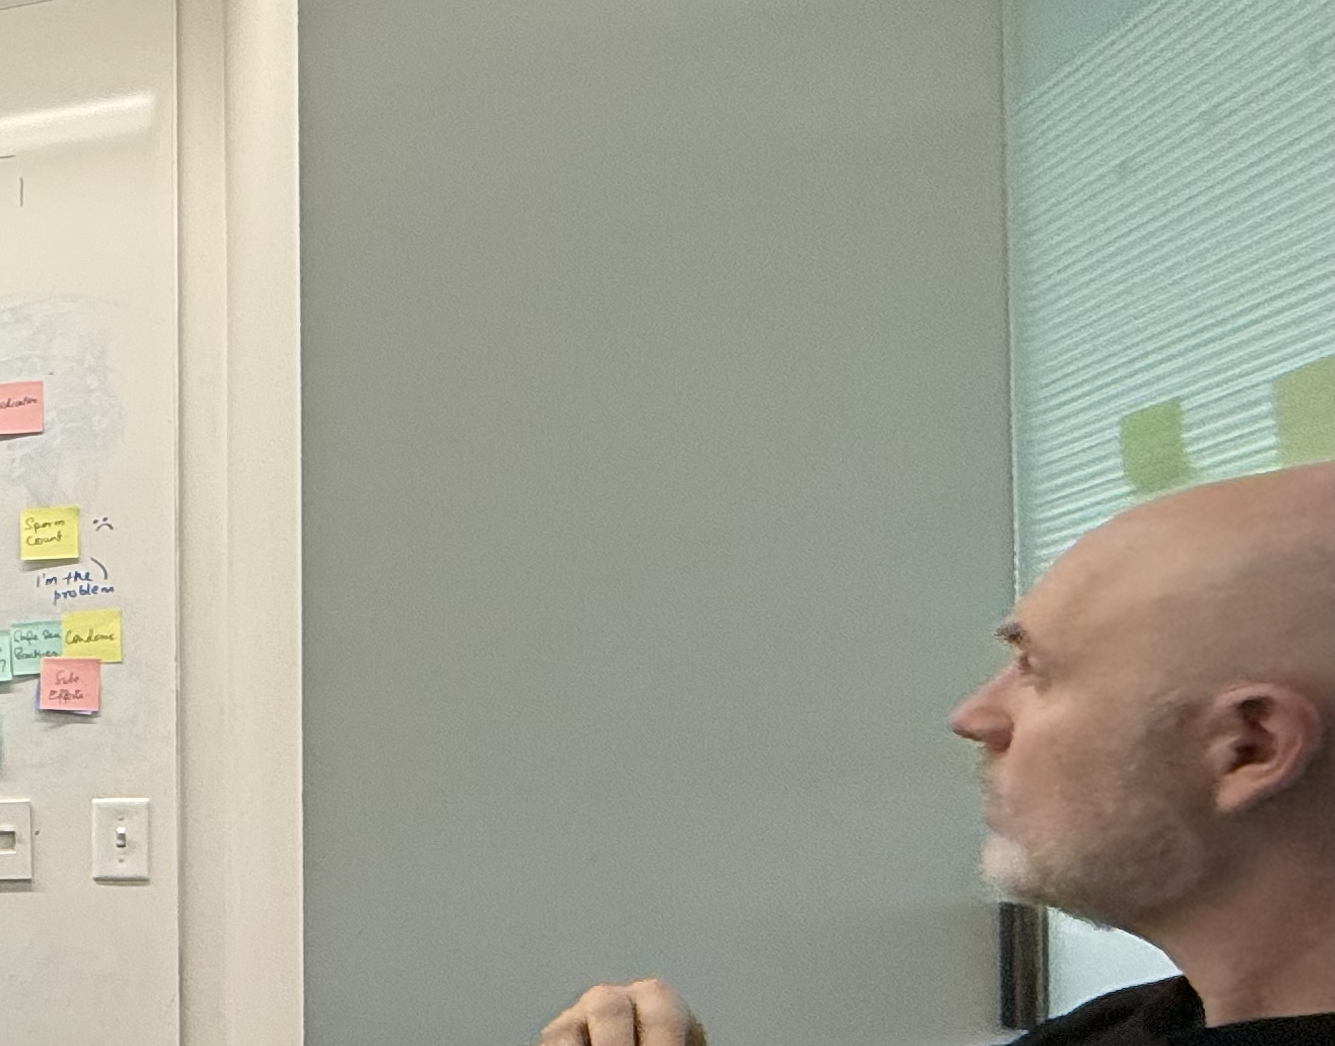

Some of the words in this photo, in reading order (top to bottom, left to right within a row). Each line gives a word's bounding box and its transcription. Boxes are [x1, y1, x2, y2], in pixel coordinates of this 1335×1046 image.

[36, 572, 58, 587] I'm
[62, 571, 93, 585] the
[54, 583, 114, 605] problem
